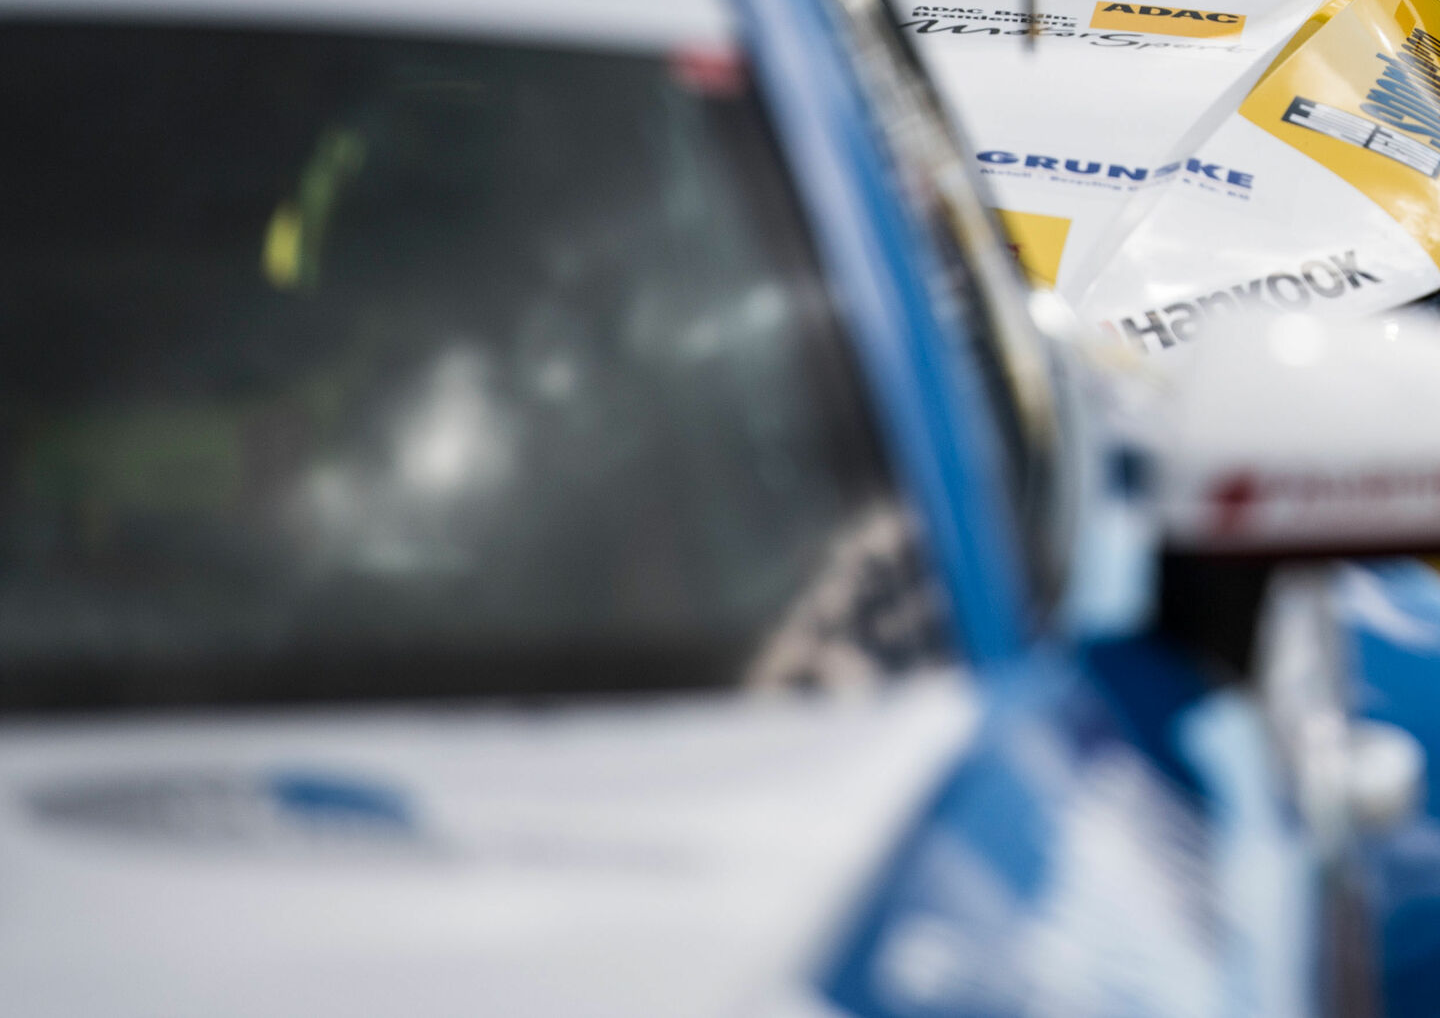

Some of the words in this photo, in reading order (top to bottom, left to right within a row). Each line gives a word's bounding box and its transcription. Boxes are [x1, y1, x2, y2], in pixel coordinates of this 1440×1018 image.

[913, 5, 984, 15] ADAC
[994, 9, 1077, 21] Belin-
[1102, 2, 1239, 24] ADAC
[975, 150, 1255, 190] GRUNSKE
